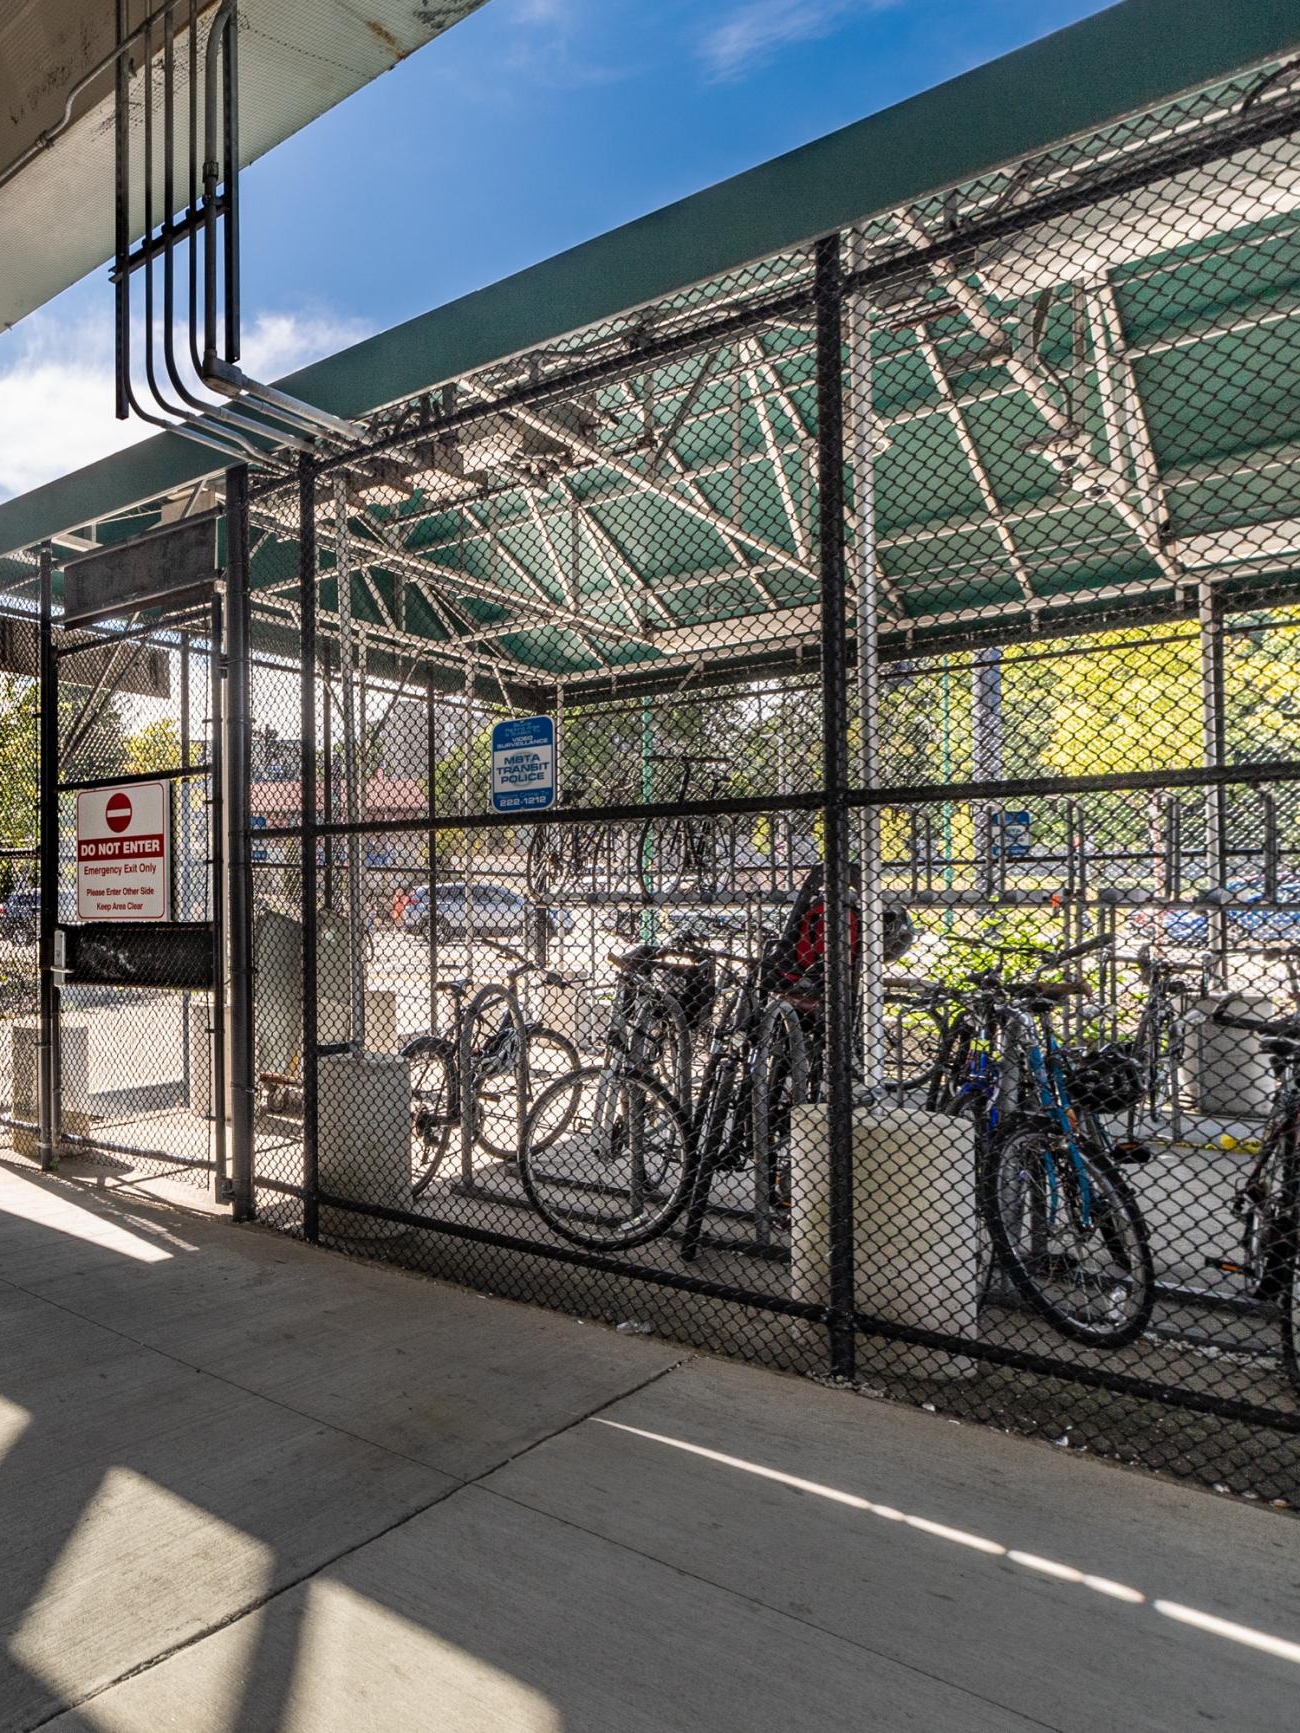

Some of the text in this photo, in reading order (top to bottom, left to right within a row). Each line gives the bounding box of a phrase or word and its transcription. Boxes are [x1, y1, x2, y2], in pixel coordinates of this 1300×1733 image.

[496, 737, 549, 750] SURVEILLANCE
[511, 735, 534, 743] VIDEO
[504, 753, 540, 765] MBTA
[496, 761, 550, 775] TRANSIT
[500, 771, 545, 785] POLICE
[80, 839, 160, 857] DO NOT ENTER
[83, 863, 157, 877] Emergency Exit Only
[86, 886, 155, 897] Please Enter Other Side
[96, 902, 143, 911] Keep Area Clear
